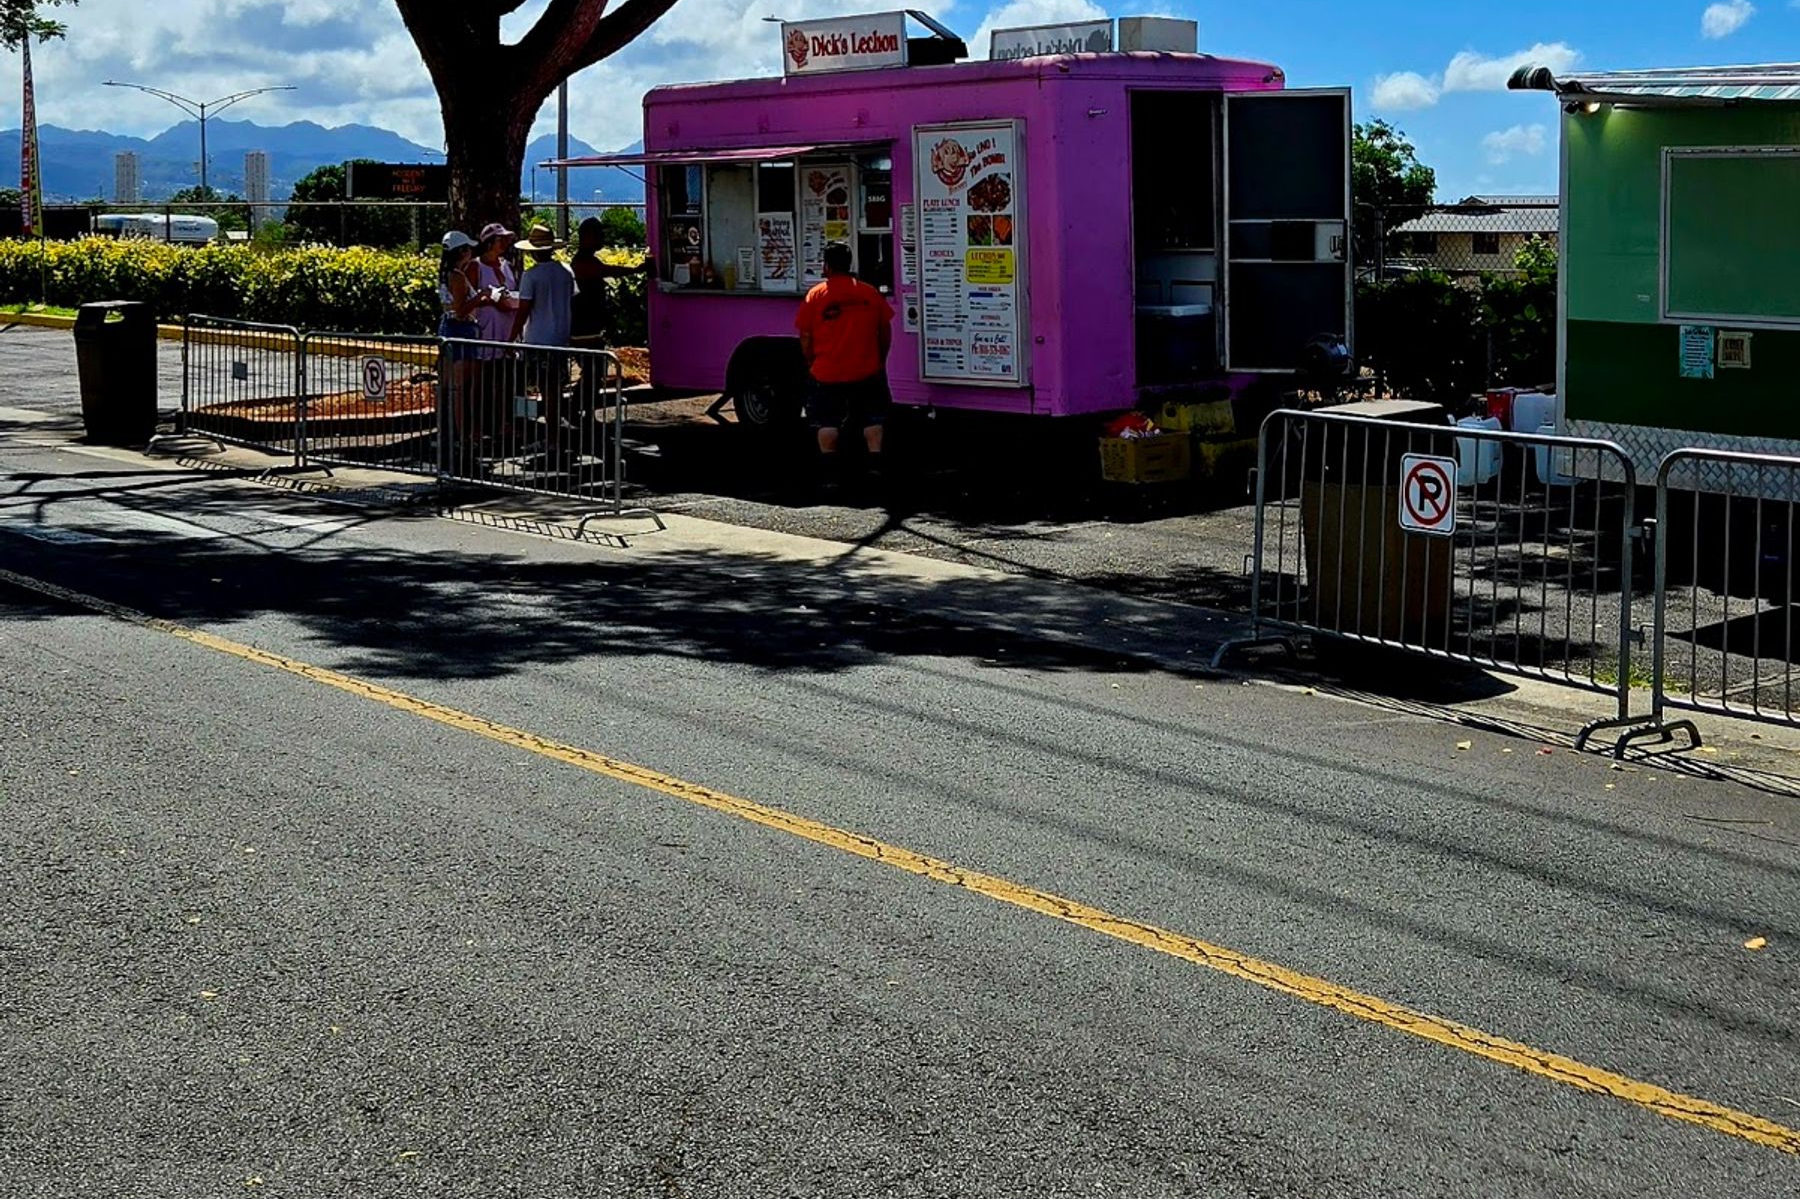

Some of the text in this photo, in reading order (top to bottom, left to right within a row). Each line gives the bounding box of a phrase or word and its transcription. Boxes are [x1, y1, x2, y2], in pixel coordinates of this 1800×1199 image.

[811, 29, 899, 57] Dick's Lechon
[1418, 475, 1442, 512] P
